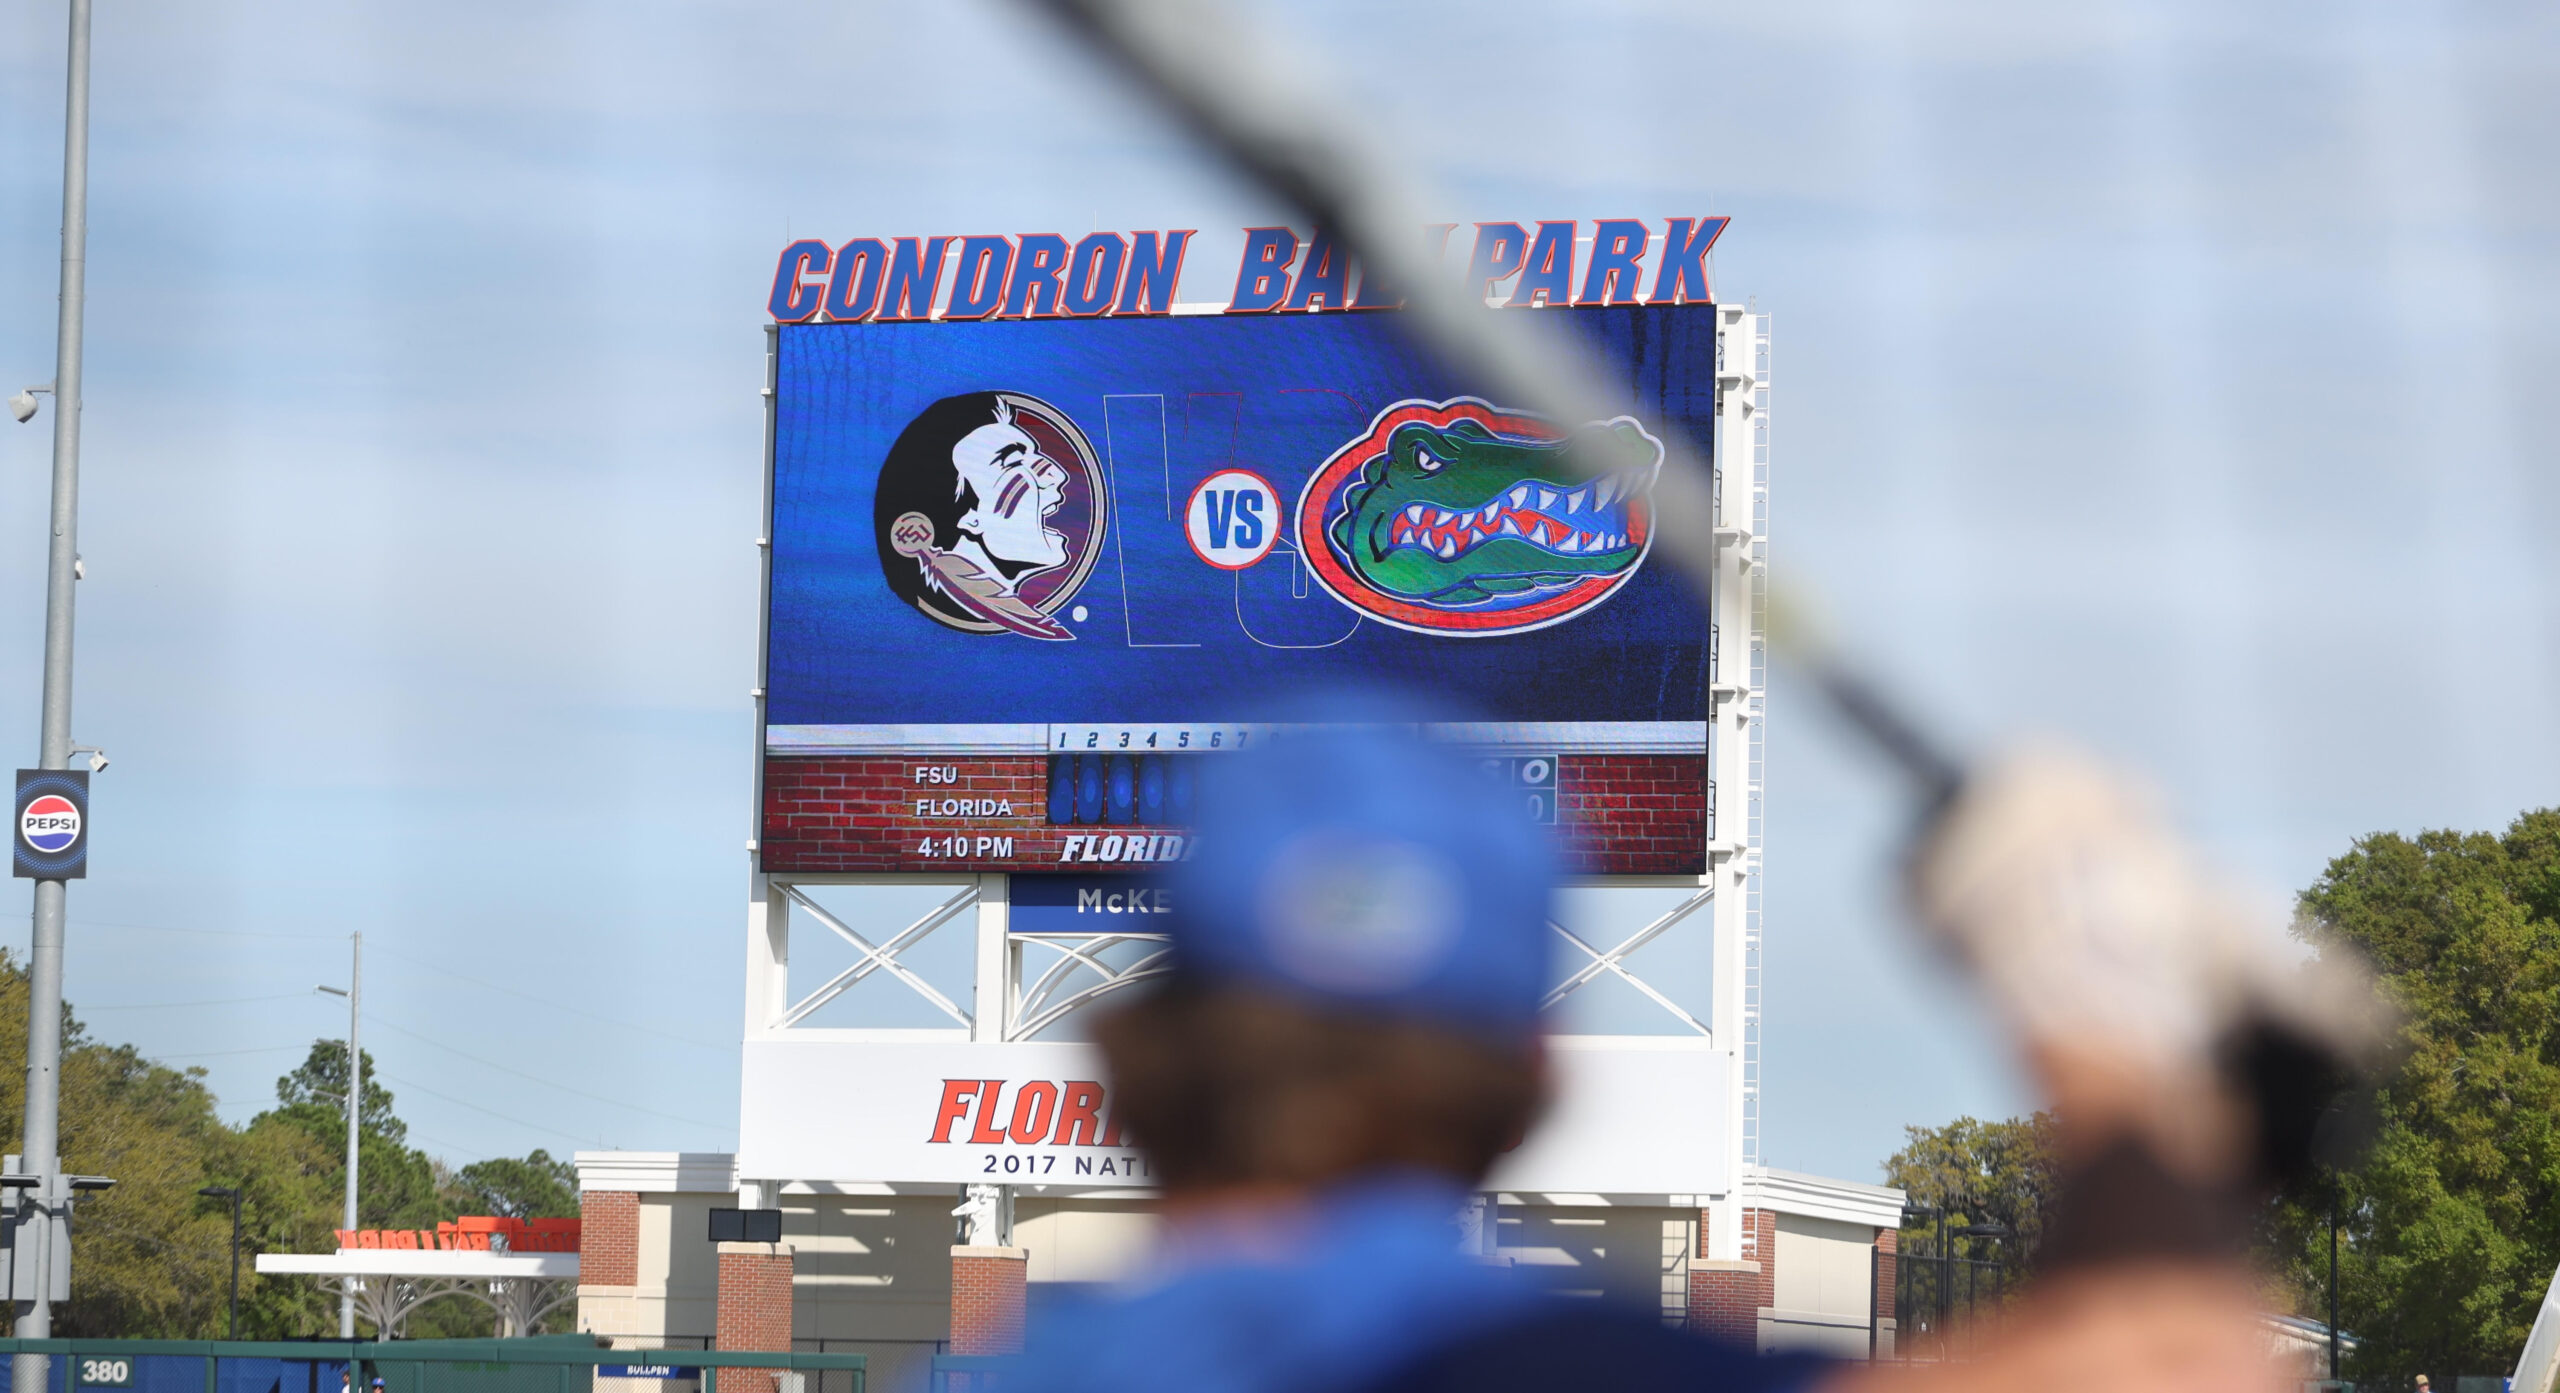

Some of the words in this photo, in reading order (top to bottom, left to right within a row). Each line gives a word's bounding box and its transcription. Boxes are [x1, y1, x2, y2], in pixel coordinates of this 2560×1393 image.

[767, 228, 1198, 323] CONDRON
[1223, 216, 1731, 313] BAPARK
[1205, 489, 1263, 549] VS
[1059, 732, 1067, 748] 1
[1087, 732, 1099, 748] 2
[1119, 732, 1130, 748] 3
[1146, 732, 1158, 748] 4
[1178, 732, 1190, 748] 5
[1210, 732, 1222, 748] 6
[915, 766, 957, 784] FSU
[916, 798, 1013, 816] FLORIDA
[26, 817, 76, 830] PEPSI
[918, 836, 969, 858] 4:10
[976, 836, 1013, 858] PM
[983, 1154, 1056, 1174] 2017
[82, 1360, 128, 1383] 380
[627, 1365, 670, 1376] BULLPEN
